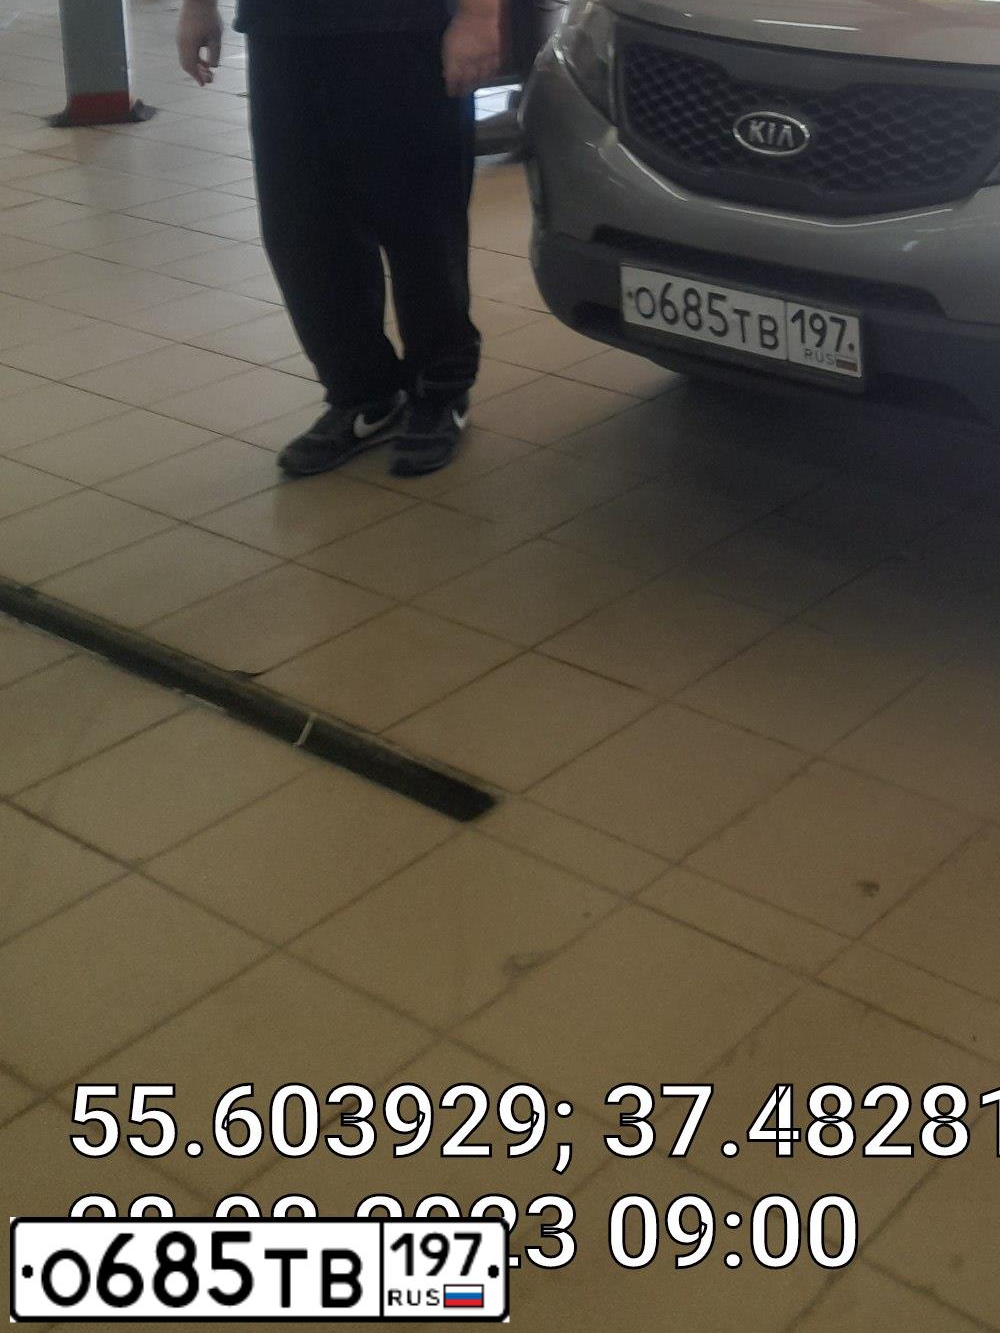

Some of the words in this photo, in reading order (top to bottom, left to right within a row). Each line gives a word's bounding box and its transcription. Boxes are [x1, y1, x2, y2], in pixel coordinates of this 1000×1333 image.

[748, 119, 795, 148] KIA
[790, 309, 848, 352] 197
[803, 348, 836, 366] RUS
